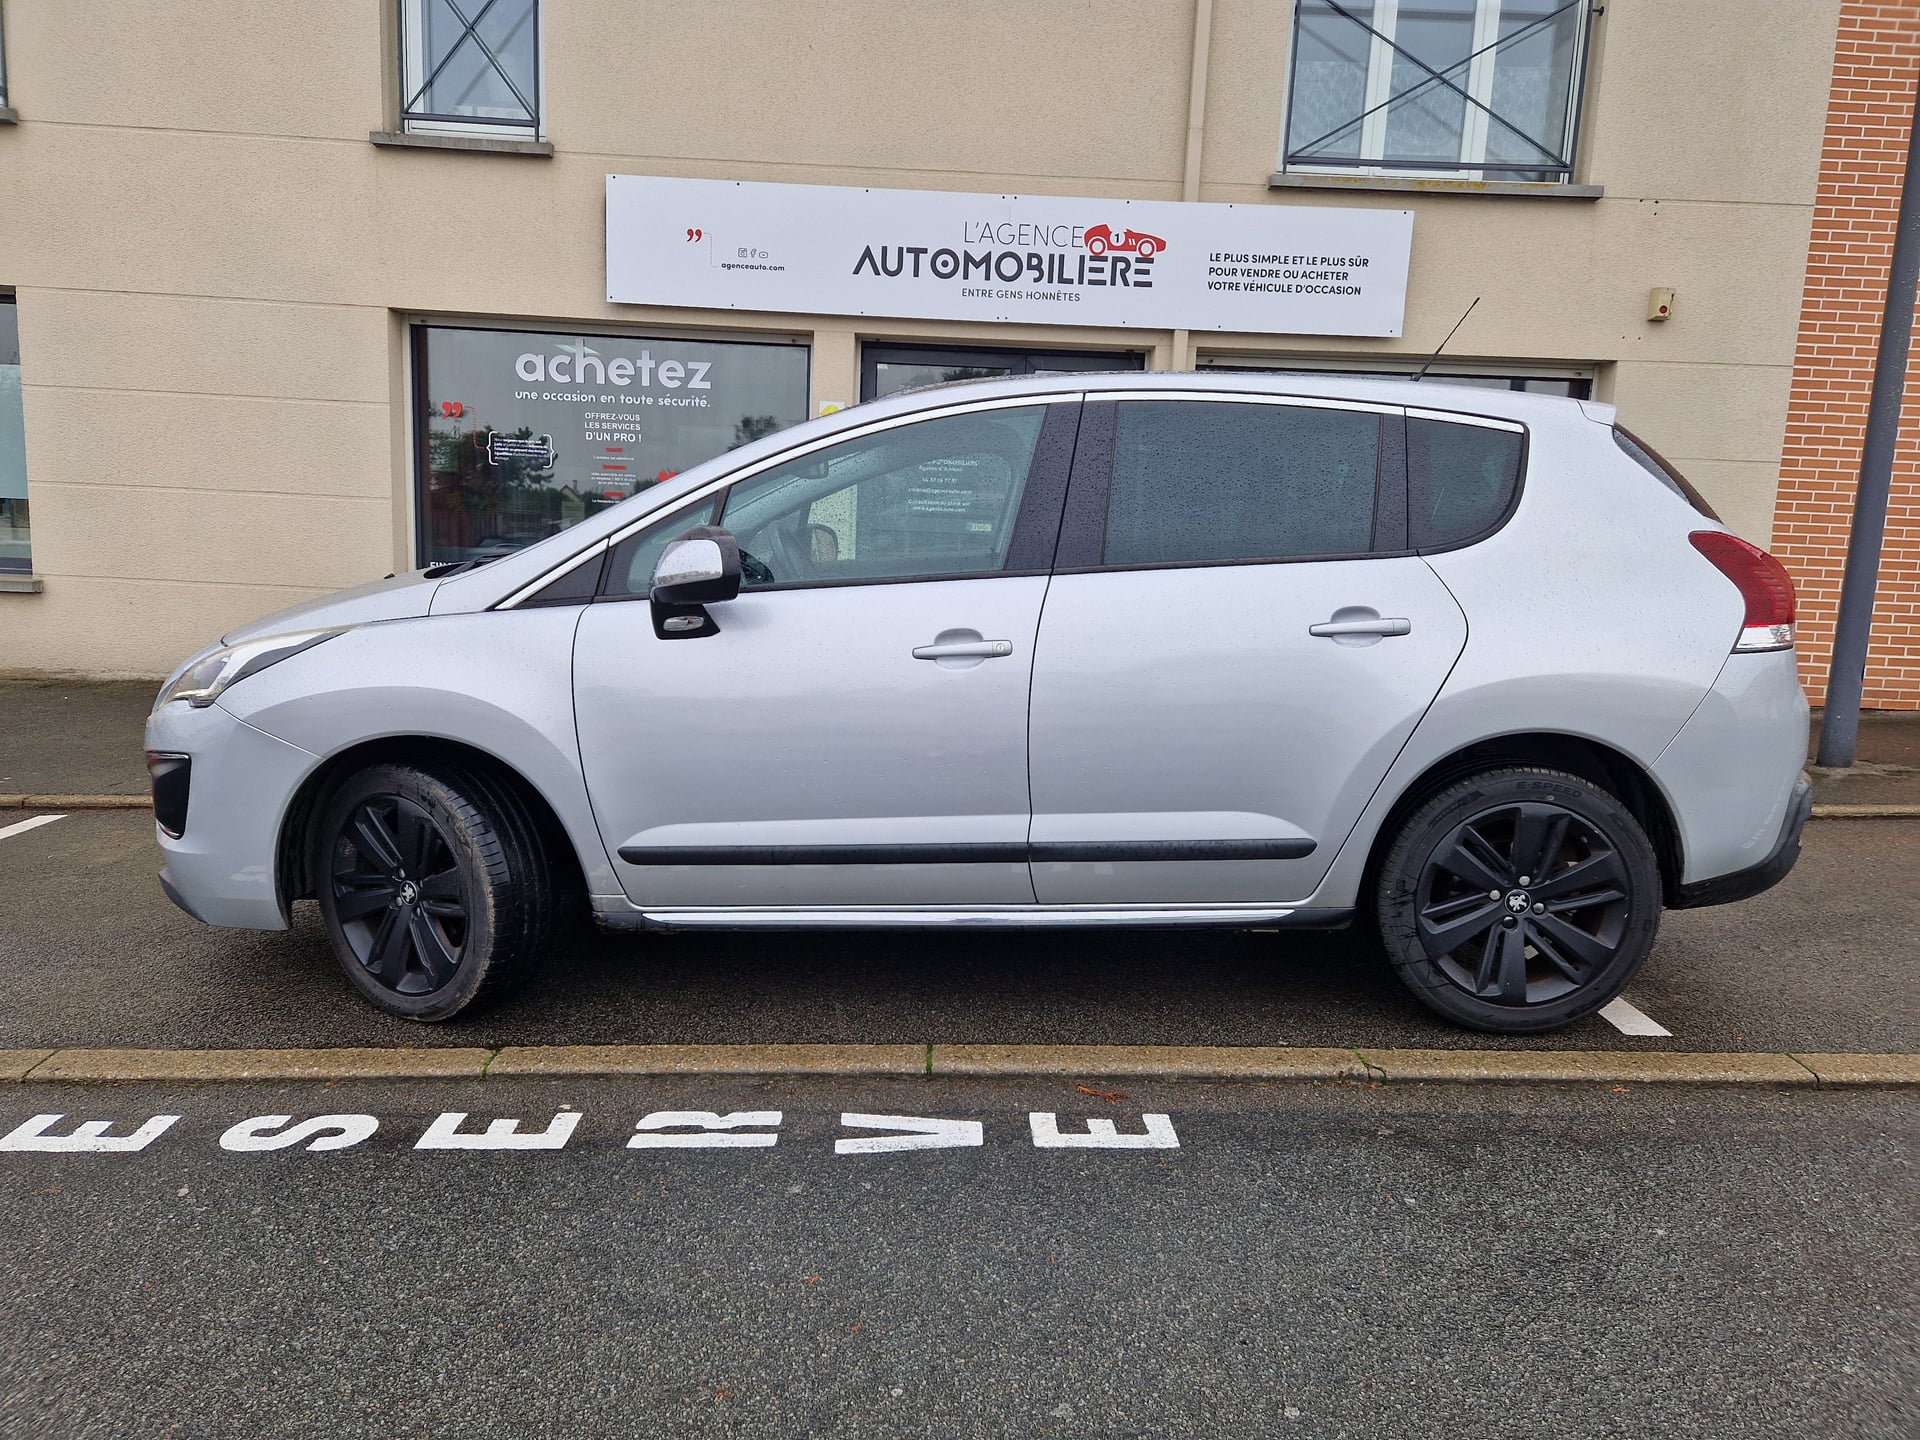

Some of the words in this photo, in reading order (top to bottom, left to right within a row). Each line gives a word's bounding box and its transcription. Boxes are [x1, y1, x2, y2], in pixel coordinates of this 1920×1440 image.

[964, 221, 1085, 248] L'AGENCE
[1209, 252, 1221, 262] LE
[1223, 253, 1249, 263] PLUS
[1251, 254, 1290, 265] SIMPLE
[1292, 255, 1304, 265] ET
[1306, 256, 1318, 266] LE
[1320, 256, 1346, 267] PLUS
[1348, 255, 1369, 267] SÛR
[721, 262, 785, 272] agenceauto.com
[1208, 267, 1238, 277] POUR
[1240, 268, 1281, 278] VENDRE
[1283, 270, 1299, 279] OU
[1300, 270, 1349, 281] ACHETER
[962, 288, 994, 299] ENTRE
[996, 289, 1023, 300] GENS
[1025, 289, 1081, 302] HONNÊTES
[1207, 281, 1241, 291] VOTRE
[1243, 280, 1293, 293] VÉHICULE
[1295, 284, 1362, 296] D'OCCASION
[515, 338, 712, 389] achetez
[515, 391, 538, 400] une
[542, 390, 596, 403] occasion
[600, 394, 615, 404] en
[619, 393, 654, 405] toute
[658, 394, 711, 408] sécurité.
[584, 412, 641, 421] OFFREZ-VOUS
[584, 421, 600, 429] LES
[601, 422, 641, 431] SERVICES
[585, 431, 611, 441] D'UN
[613, 432, 636, 442] PRO
